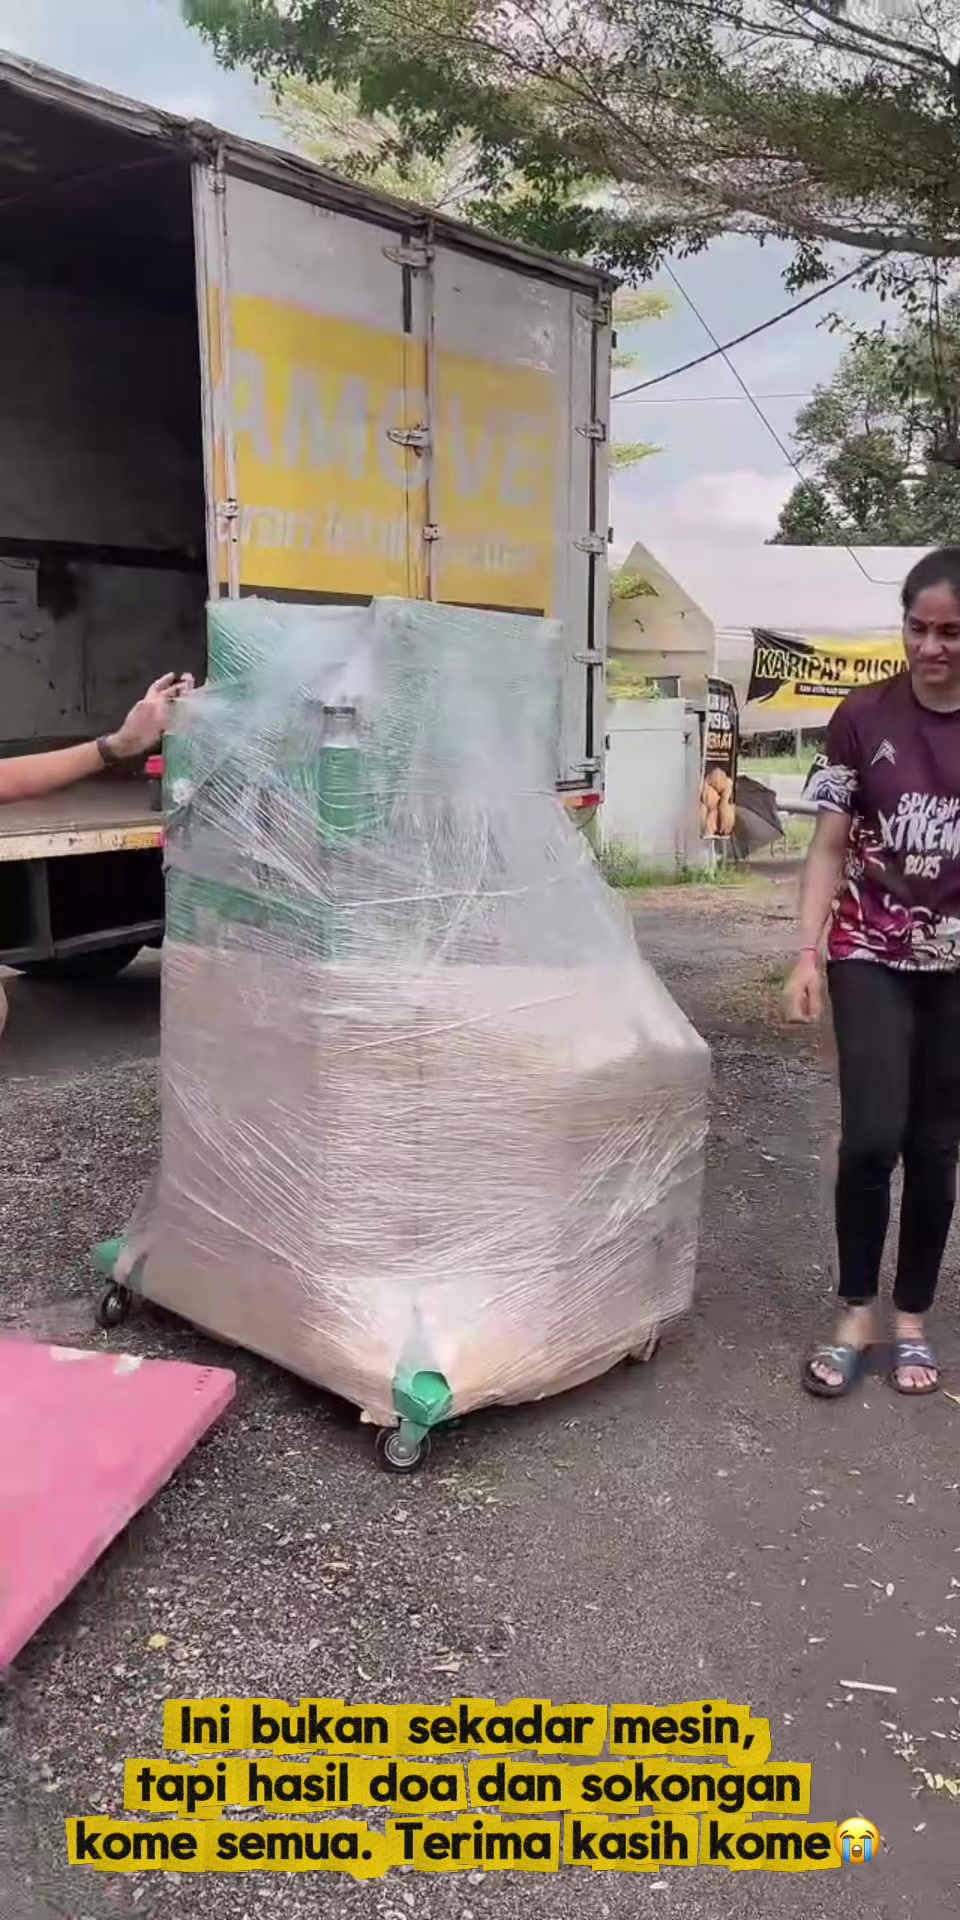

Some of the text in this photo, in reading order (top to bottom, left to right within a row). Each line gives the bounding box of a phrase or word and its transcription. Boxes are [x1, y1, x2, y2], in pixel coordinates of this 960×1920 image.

[755, 648, 847, 682] KARIPAP
[897, 792, 960, 818] SPLASH
[904, 854, 942, 879] 2025
